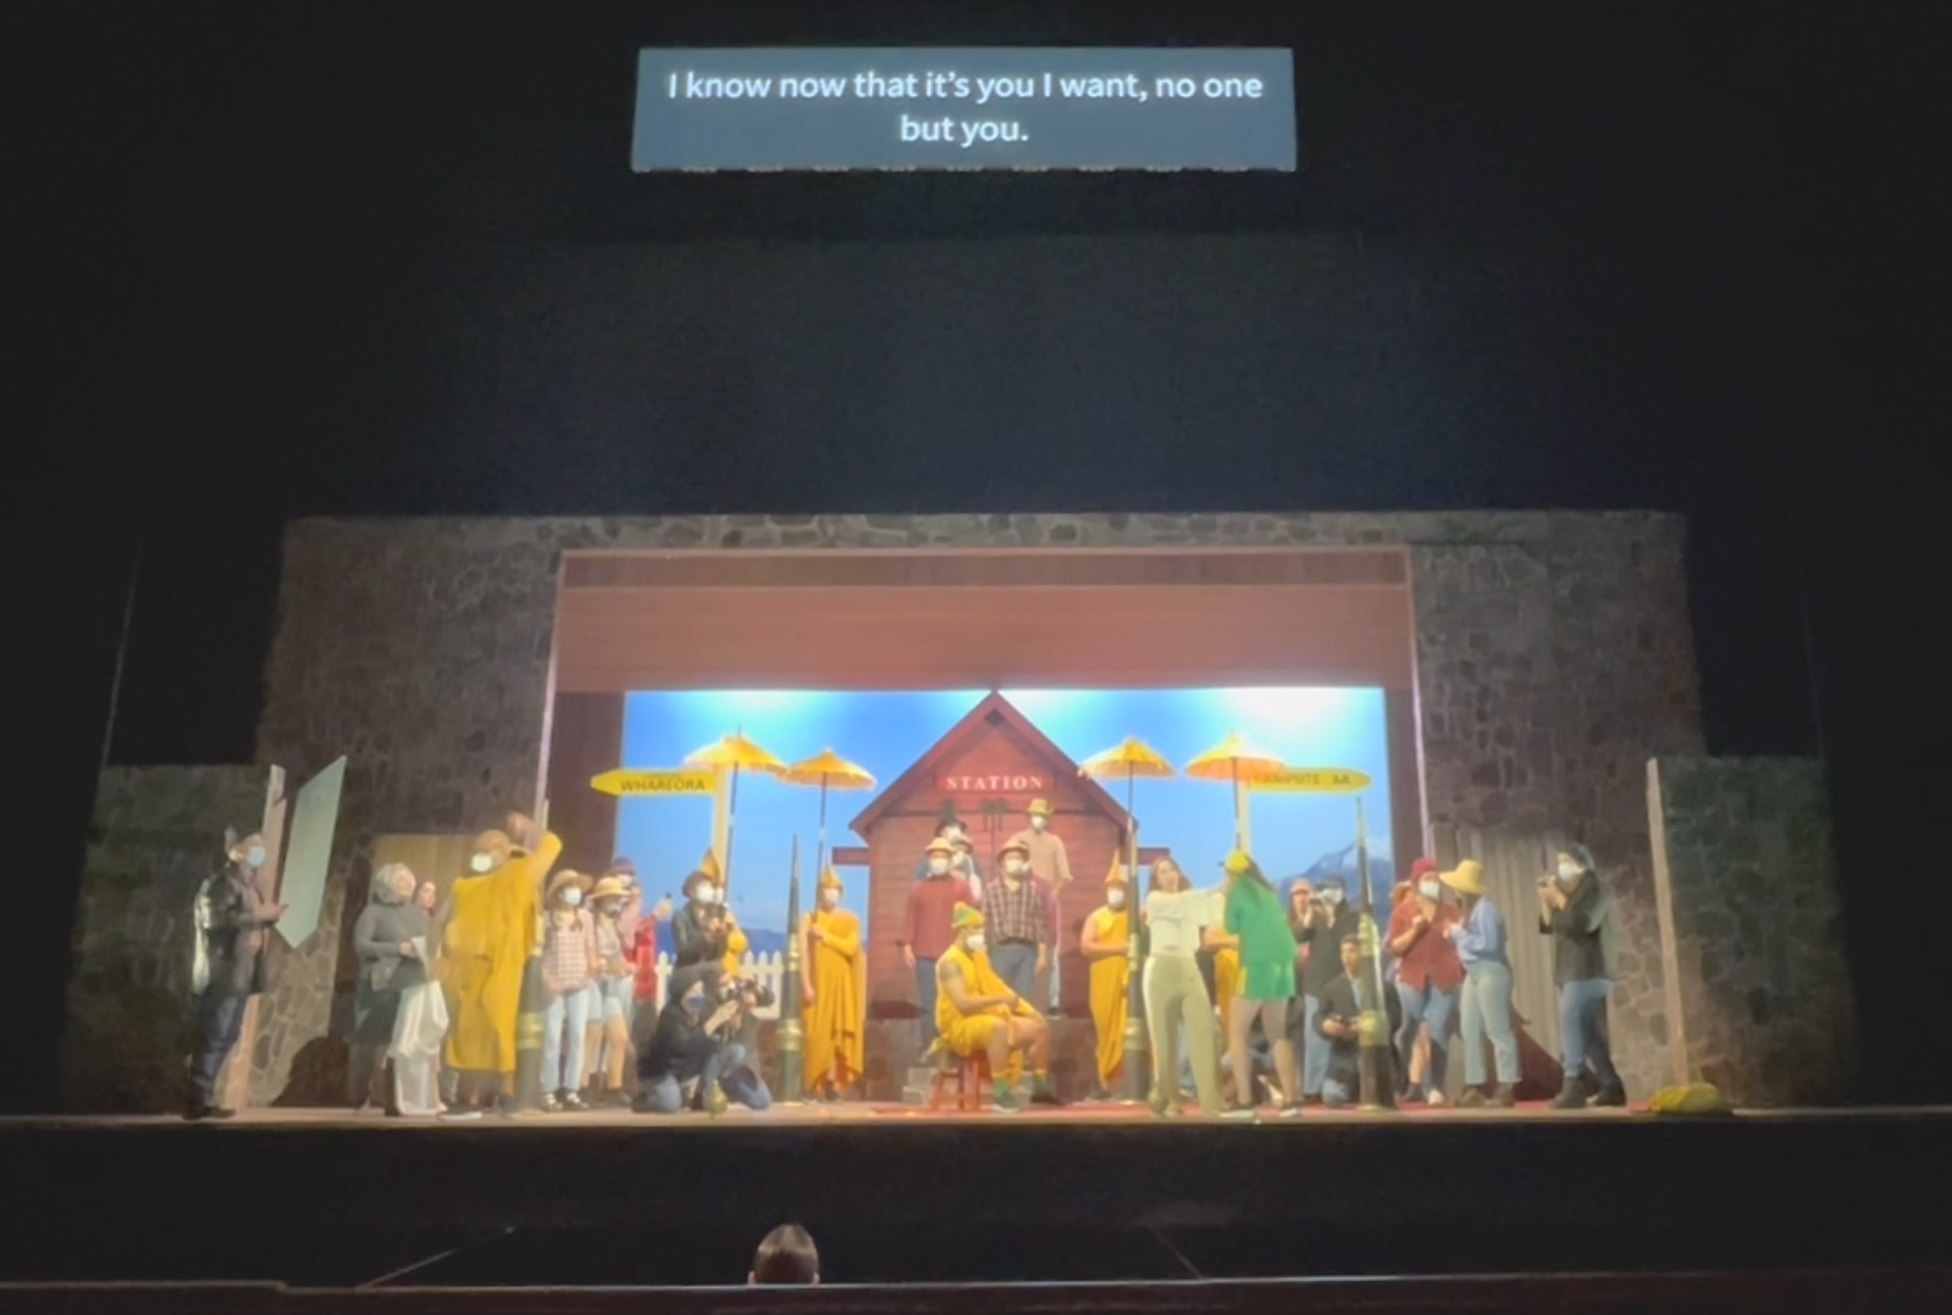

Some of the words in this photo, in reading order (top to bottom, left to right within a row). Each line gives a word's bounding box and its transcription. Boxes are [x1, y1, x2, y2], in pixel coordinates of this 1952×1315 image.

[669, 73, 677, 99] I
[686, 71, 772, 99] know
[779, 77, 847, 99] now
[853, 71, 919, 99] that
[925, 71, 971, 99] it’s
[976, 77, 1035, 106] you
[1043, 72, 1052, 98] I
[1059, 72, 1148, 103] want,
[1155, 77, 1197, 99] no
[1202, 77, 1263, 99] one
[900, 114, 955, 142] but
[960, 121, 1029, 149] you.
[945, 775, 1043, 790] STATION
